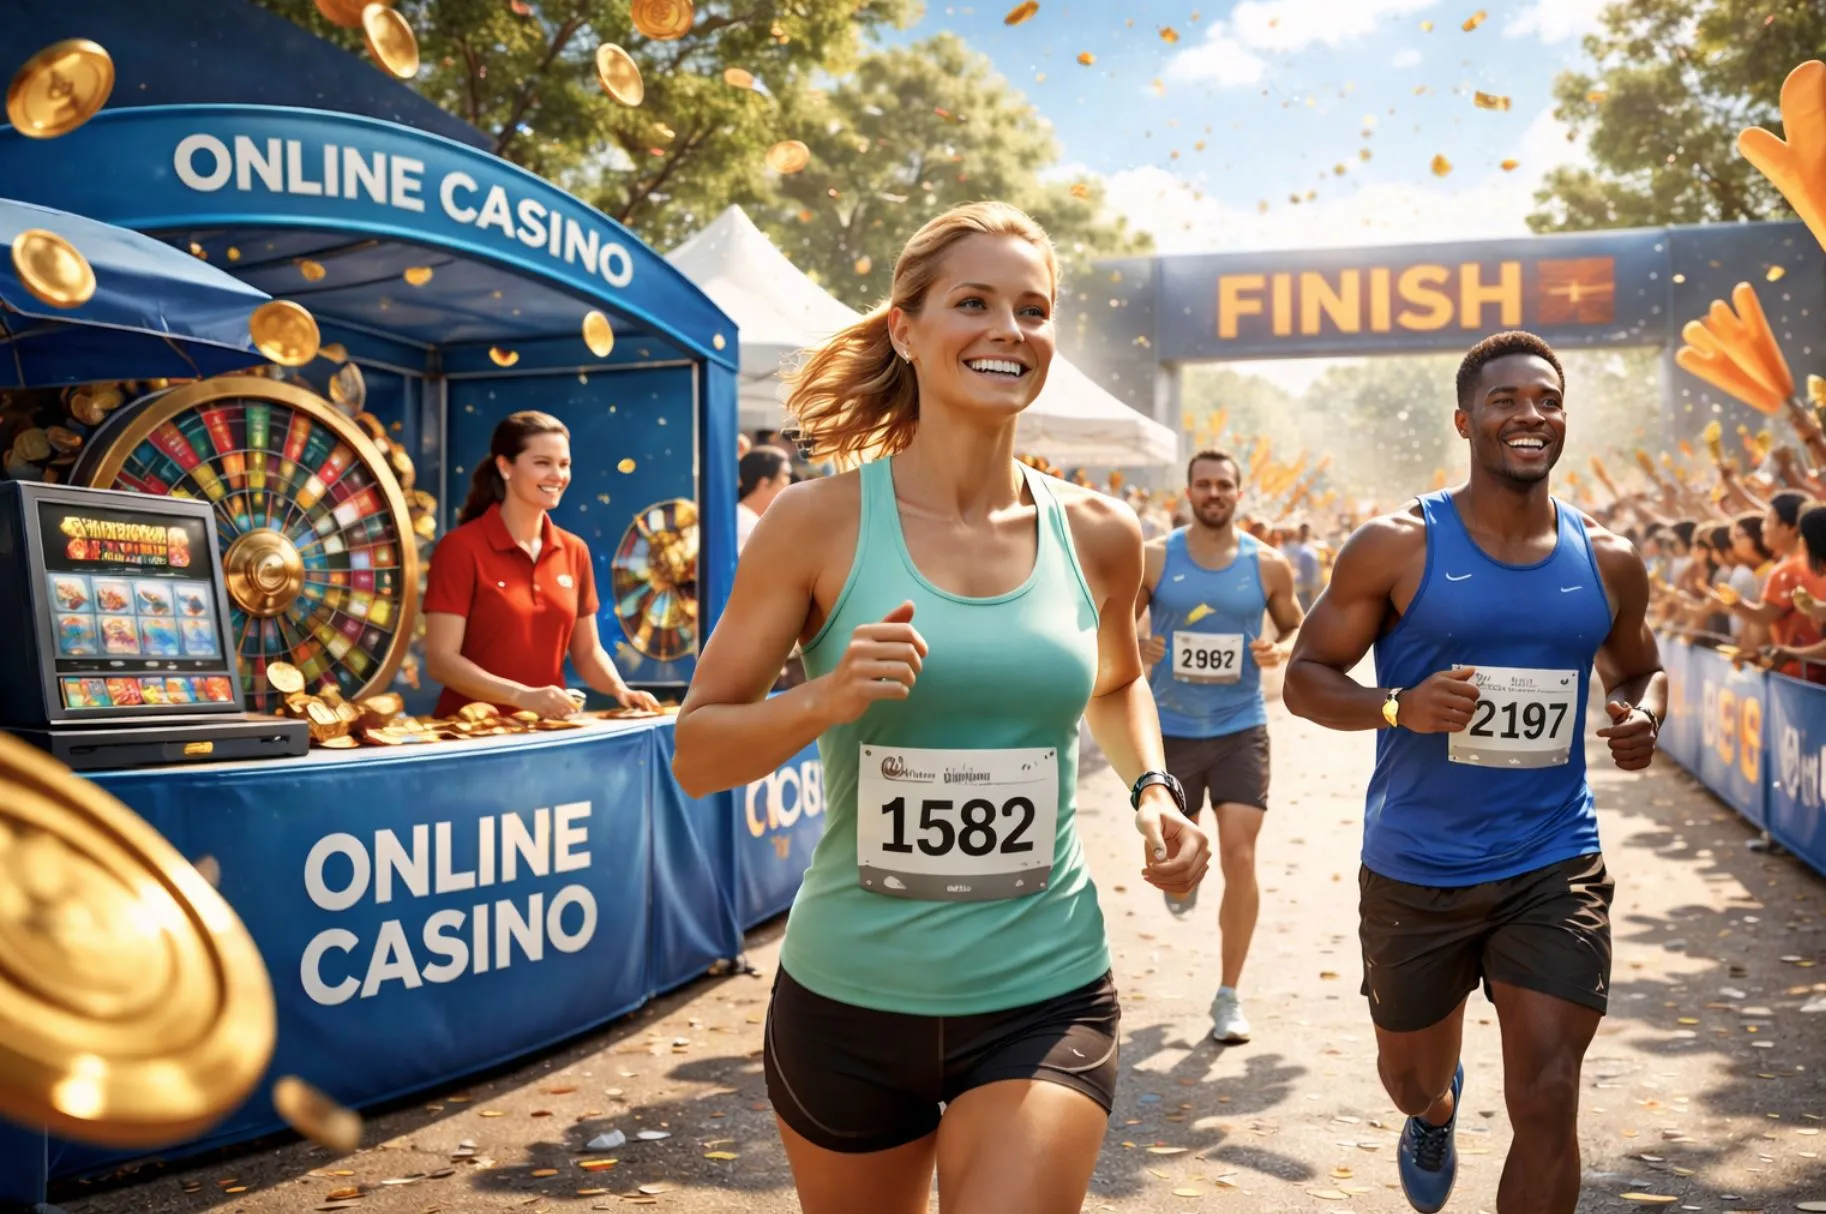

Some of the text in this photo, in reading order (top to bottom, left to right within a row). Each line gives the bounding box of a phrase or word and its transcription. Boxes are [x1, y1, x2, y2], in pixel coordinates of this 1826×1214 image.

[173, 133, 634, 289] ONLINE CASINO
[1217, 260, 1523, 340] FINISH
[1469, 699, 1568, 740] 2197
[304, 800, 592, 911] ONLINE
[881, 796, 1036, 857] 1582
[300, 884, 598, 1006] CASINO
